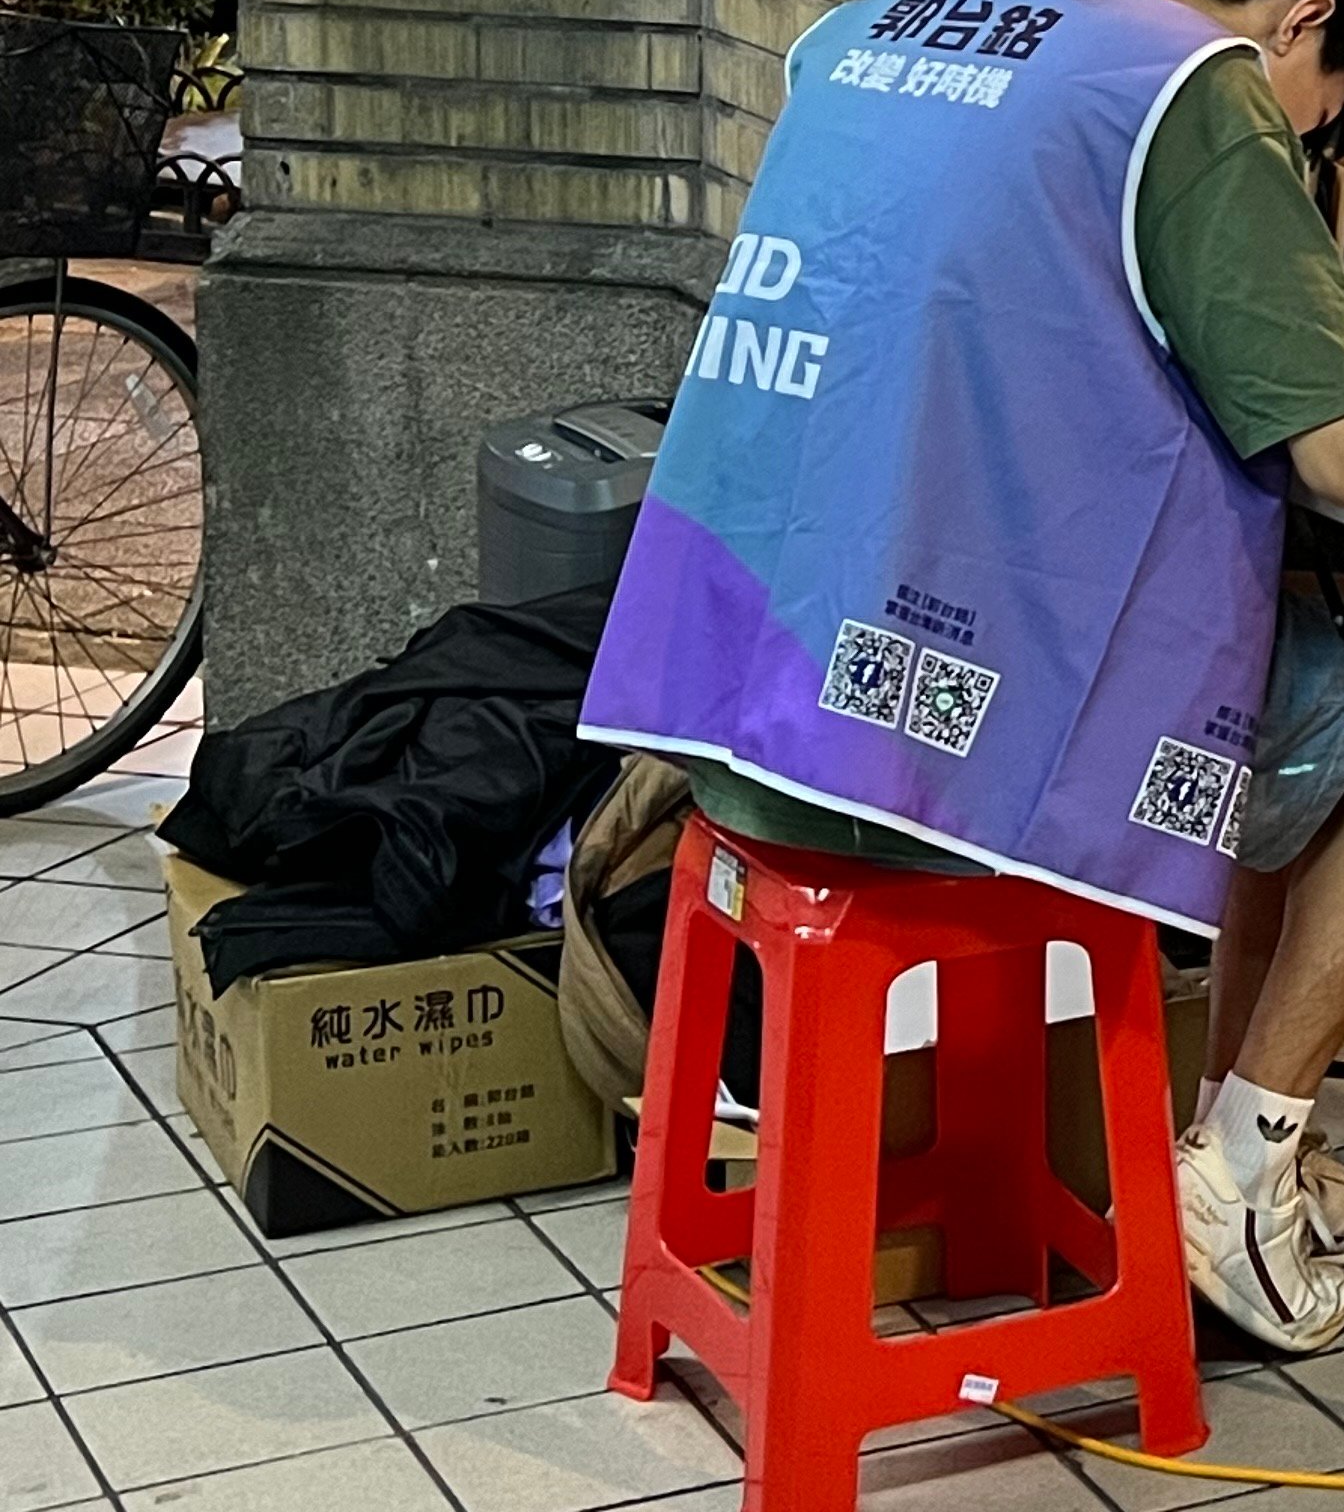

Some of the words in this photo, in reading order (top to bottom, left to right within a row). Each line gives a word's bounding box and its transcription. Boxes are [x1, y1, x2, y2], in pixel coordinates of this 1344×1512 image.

[684, 315, 829, 399] ING
[311, 985, 504, 1048] 純水濕巾
[325, 1045, 401, 1069] water
[419, 1030, 494, 1056] wipes
